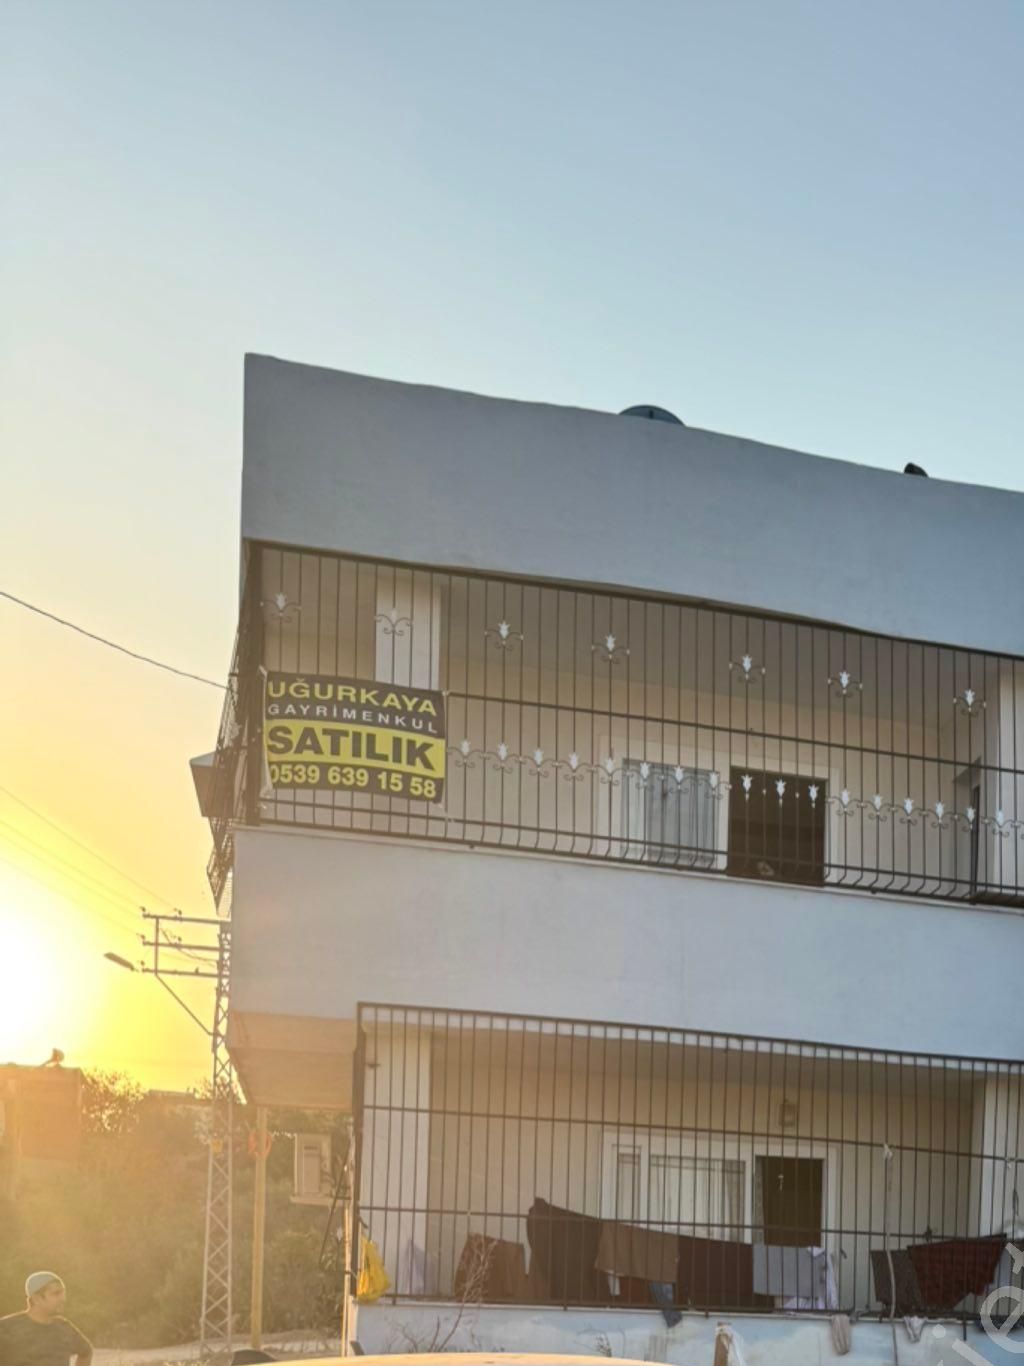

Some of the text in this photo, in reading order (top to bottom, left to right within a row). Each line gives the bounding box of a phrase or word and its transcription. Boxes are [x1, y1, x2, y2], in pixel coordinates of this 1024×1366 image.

[267, 678, 437, 717] UĞURKAYA
[267, 703, 438, 734] GAYRİMENKUL
[266, 726, 435, 771] SATILIK
[270, 764, 436, 799] 0539 639 15 58
